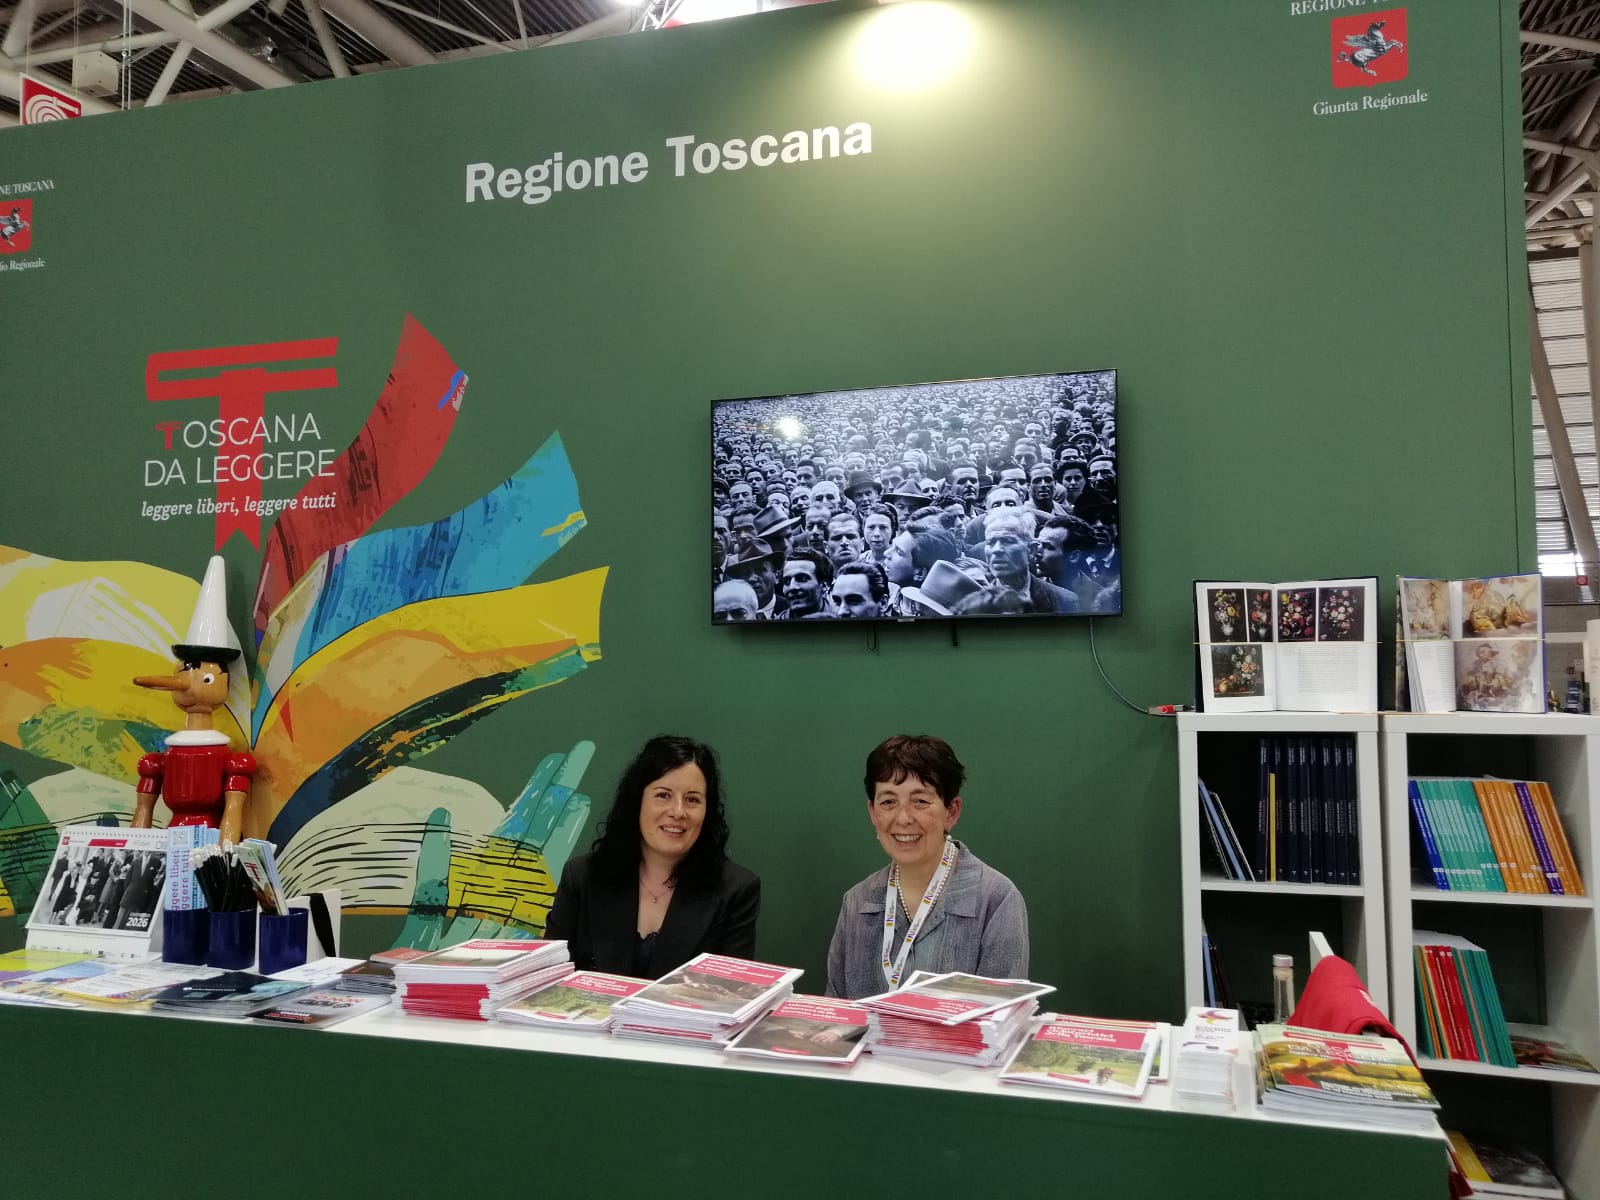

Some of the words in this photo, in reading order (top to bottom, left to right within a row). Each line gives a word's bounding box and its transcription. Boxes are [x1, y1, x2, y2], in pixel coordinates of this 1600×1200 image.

[1312, 100, 1358, 116] Giunta
[1362, 89, 1428, 110] Regionale
[466, 151, 649, 205] Regione
[666, 121, 873, 177] Toscana
[12, 179, 55, 193] TOSCANA
[9, 257, 46, 271] Regionale
[154, 412, 321, 451] TOSCANA
[144, 458, 187, 487] DA
[196, 448, 336, 484] LEGGERE
[141, 501, 193, 521] leggere
[196, 496, 240, 516] liberi,
[244, 495, 298, 517] leggere
[302, 492, 337, 510] tutti
[169, 850, 180, 878] liberi
[126, 917, 149, 928] 2026
